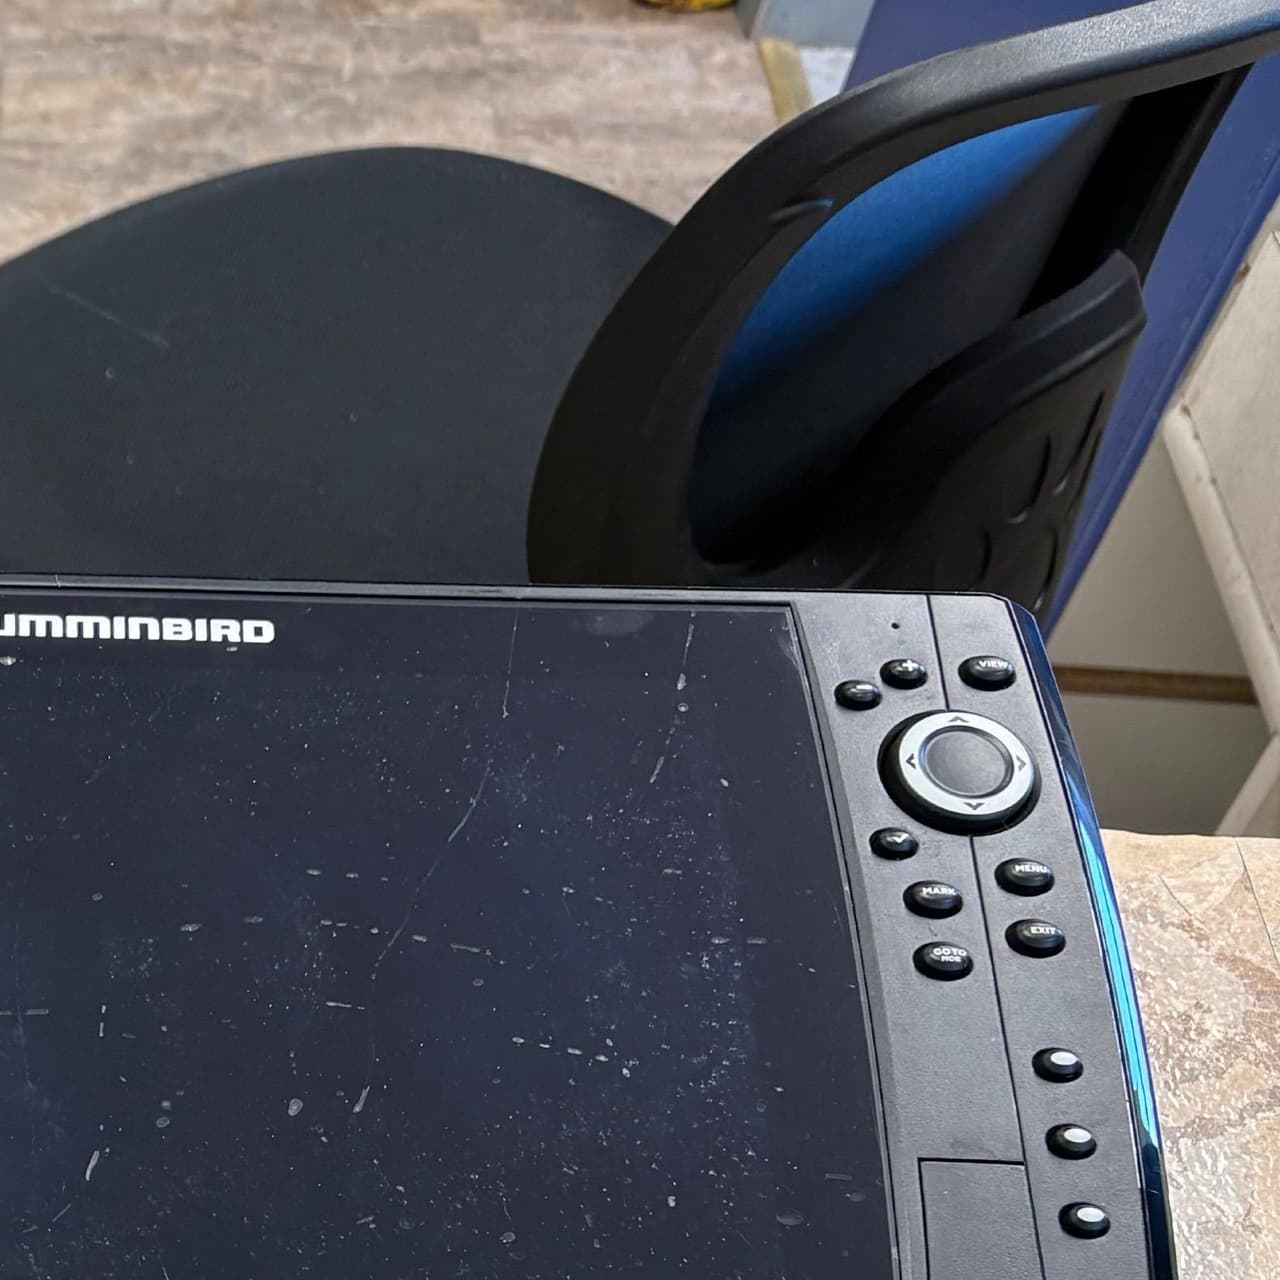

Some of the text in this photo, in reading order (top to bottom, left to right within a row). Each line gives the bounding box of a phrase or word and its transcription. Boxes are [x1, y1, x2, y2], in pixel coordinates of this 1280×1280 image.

[978, 660, 1008, 669] VIEW
[1015, 864, 1048, 873] MENU
[922, 886, 957, 896] MARK
[1030, 926, 1056, 935] EXIT
